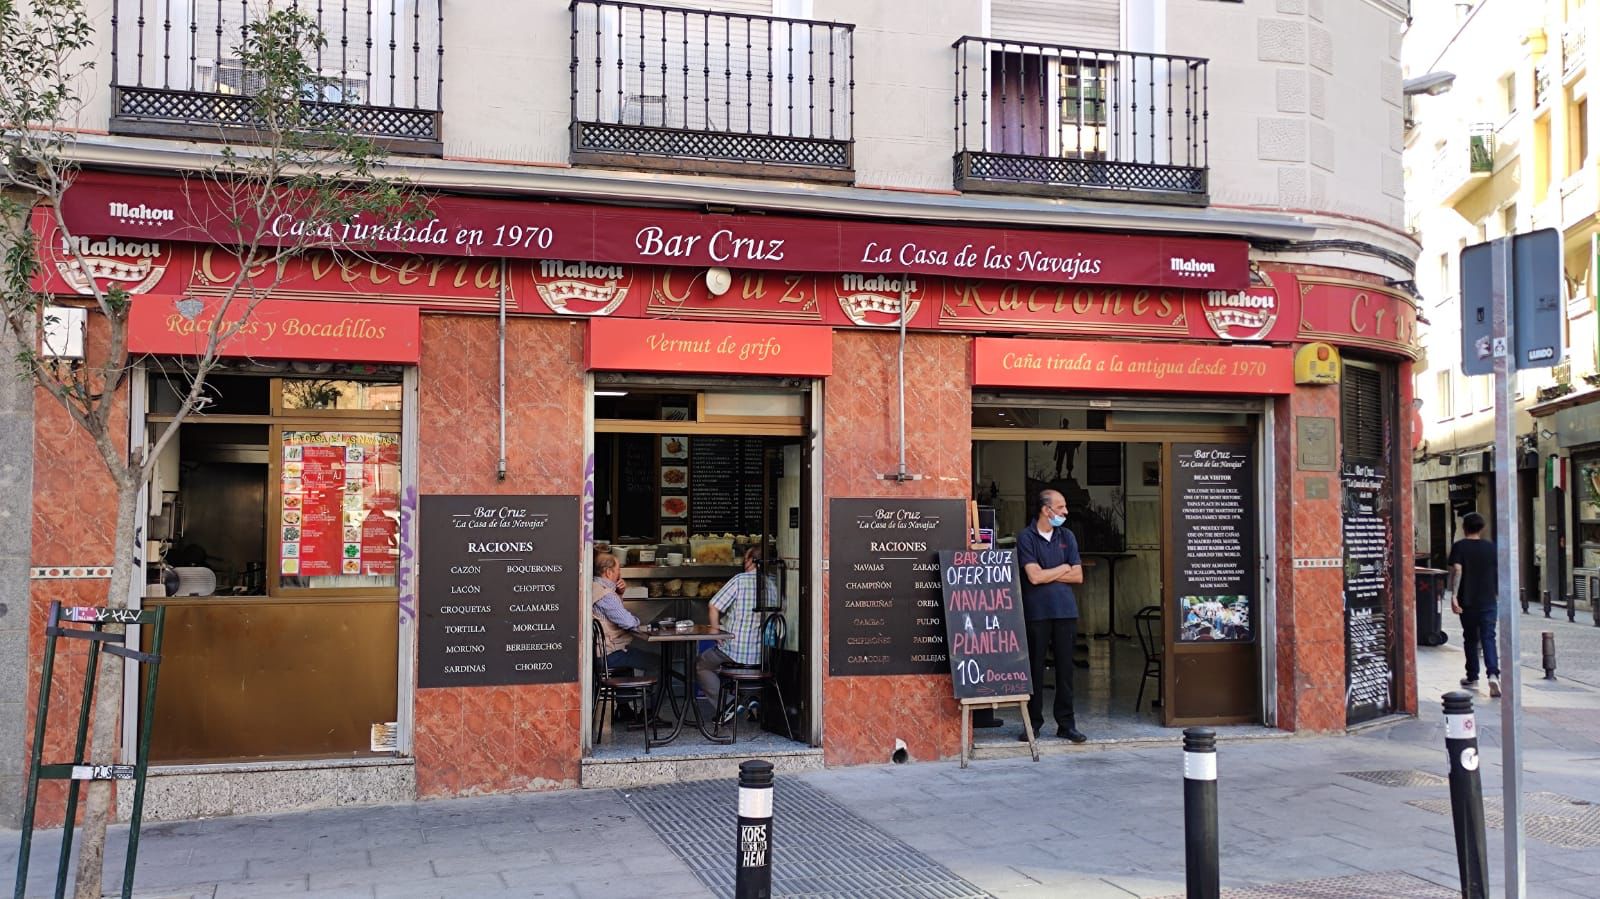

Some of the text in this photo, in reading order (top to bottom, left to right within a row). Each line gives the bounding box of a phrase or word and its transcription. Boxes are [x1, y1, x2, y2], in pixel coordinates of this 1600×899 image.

[109, 201, 174, 221] Mahou
[272, 213, 553, 249] Casa fundada en 1970
[61, 235, 161, 257] Mahou
[635, 226, 785, 262] Bar Cruz
[861, 242, 1102, 279] La Casa de las Navajas
[1170, 257, 1215, 273] Mahou
[540, 259, 624, 280] Mahou
[662, 266, 806, 304] Cuz
[842, 274, 918, 293] Mahou
[1207, 290, 1275, 309] Mahou
[261, 321, 277, 341] y
[282, 318, 387, 339] Bocadillos
[646, 333, 781, 361] Vermut de grifo
[1003, 351, 1267, 377] Caña tirada a la antigua desde 1970
[1194, 449, 1231, 460] Bar Cruz
[473, 505, 527, 519] Bar Cruz
[875, 508, 921, 520] Bar Cruz
[468, 519, 487, 529] Casa
[488, 518, 498, 528] de
[499, 518, 511, 528] las
[870, 520, 887, 529] Casa
[888, 520, 896, 529] de
[897, 520, 907, 529] las
[467, 541, 534, 553] RACIONES
[870, 541, 927, 552] RACIONES
[954, 550, 1013, 566] BAR CRUZ
[450, 564, 563, 574] CAZÓN BOQUERONES
[854, 563, 940, 571] NAVAJAS ZARAJO
[946, 565, 1012, 585] OFERTON
[450, 584, 556, 594] LACÓN CHOPITOS
[845, 580, 941, 590] CHAMPIÑÓN BRAVAS
[844, 598, 939, 609] ZAMBURIÑAS OREJA
[949, 587, 1014, 612] NAVAJAS
[440, 603, 560, 614] CROQUETAS CALAMARES
[445, 623, 556, 634] TORTILLA MORCILLA
[916, 617, 940, 626] PULPO
[964, 615, 1000, 631] A LA
[912, 635, 943, 644] PADRÓN
[953, 630, 1020, 655] PLANCHA
[446, 642, 563, 654] MORUNO BERBERECHOS
[911, 653, 946, 663] MOLLEJAS
[444, 662, 553, 674] SARDINAS CHORIZO
[986, 669, 1028, 683] Docena
[741, 825, 767, 842] KORS
[742, 851, 766, 867] HEM
